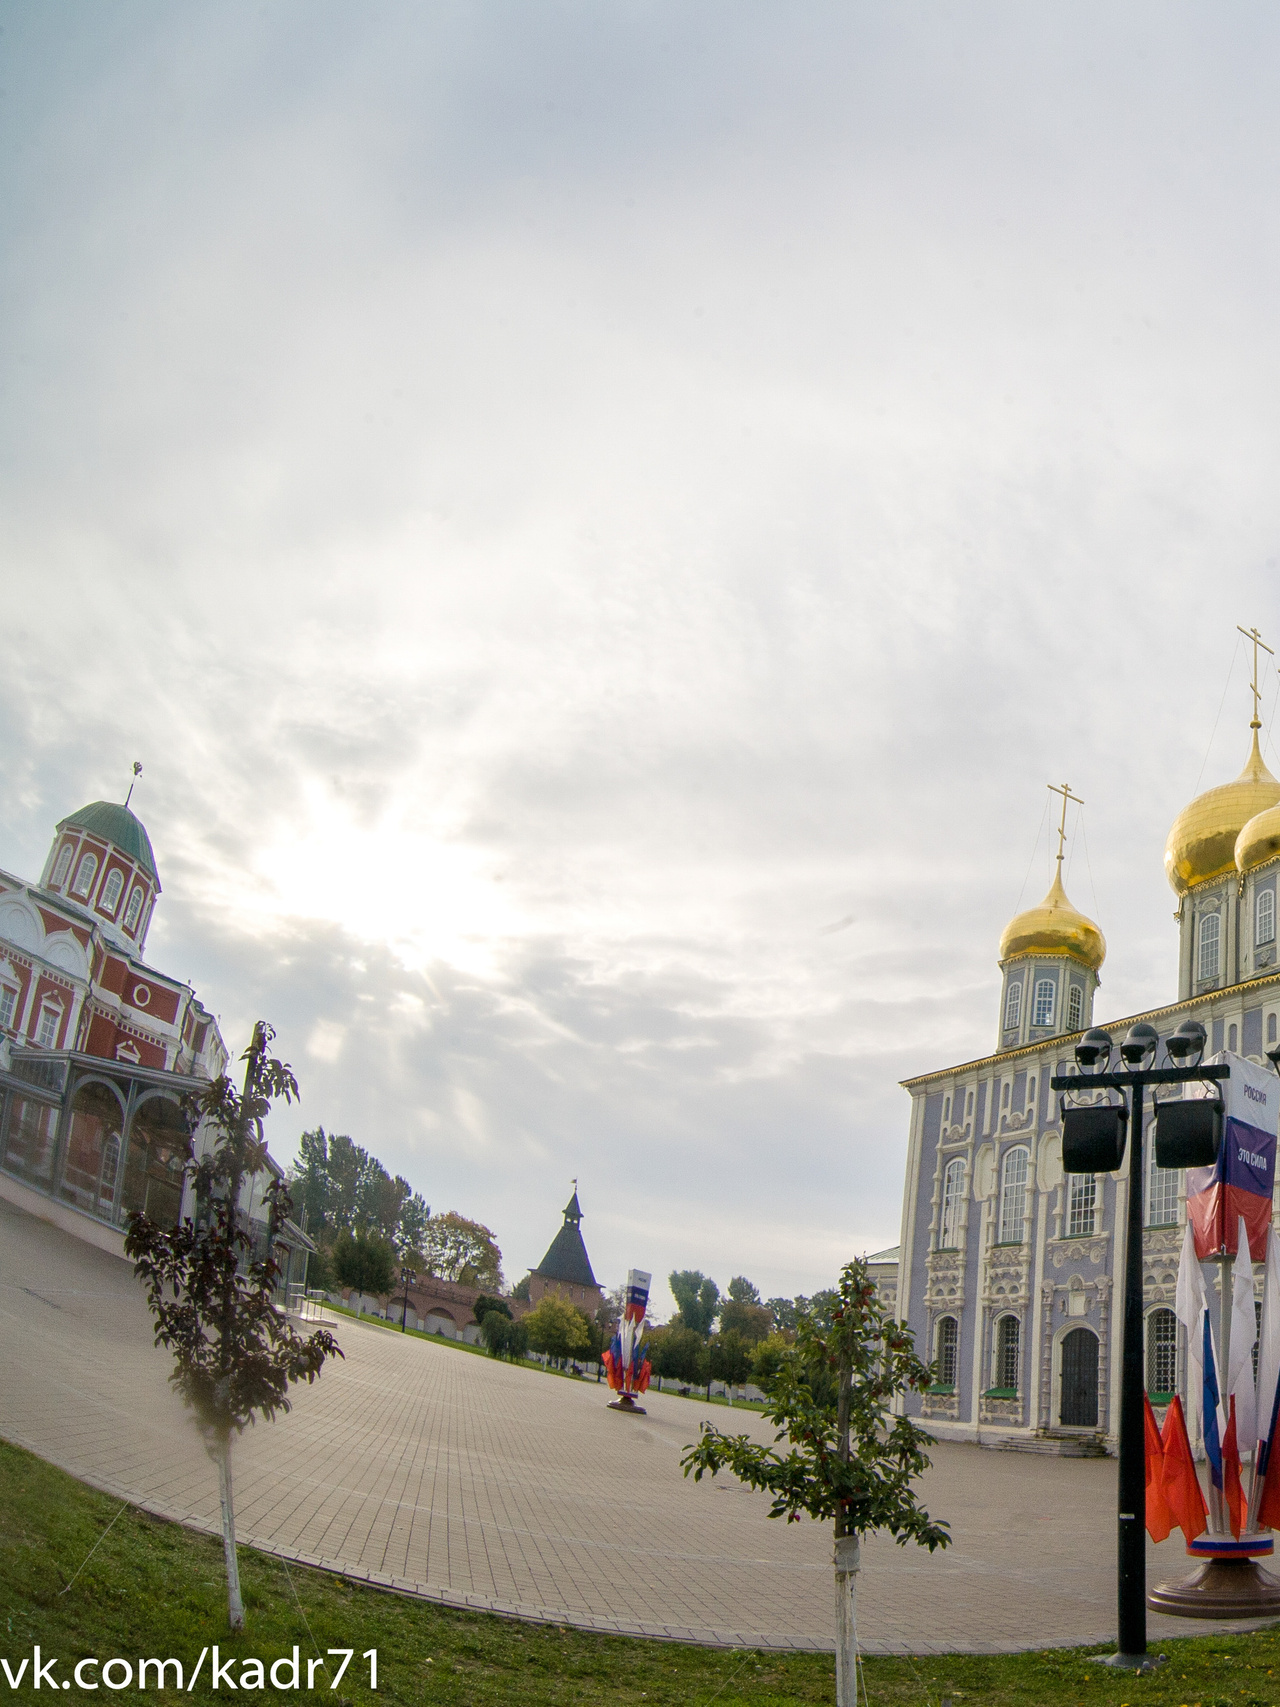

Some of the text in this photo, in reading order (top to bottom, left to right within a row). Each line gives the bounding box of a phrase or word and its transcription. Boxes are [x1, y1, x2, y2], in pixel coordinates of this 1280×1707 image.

[1244, 1084, 1267, 1106] РОССИЯ
[1238, 1148, 1267, 1171] ЭТО СИЛА
